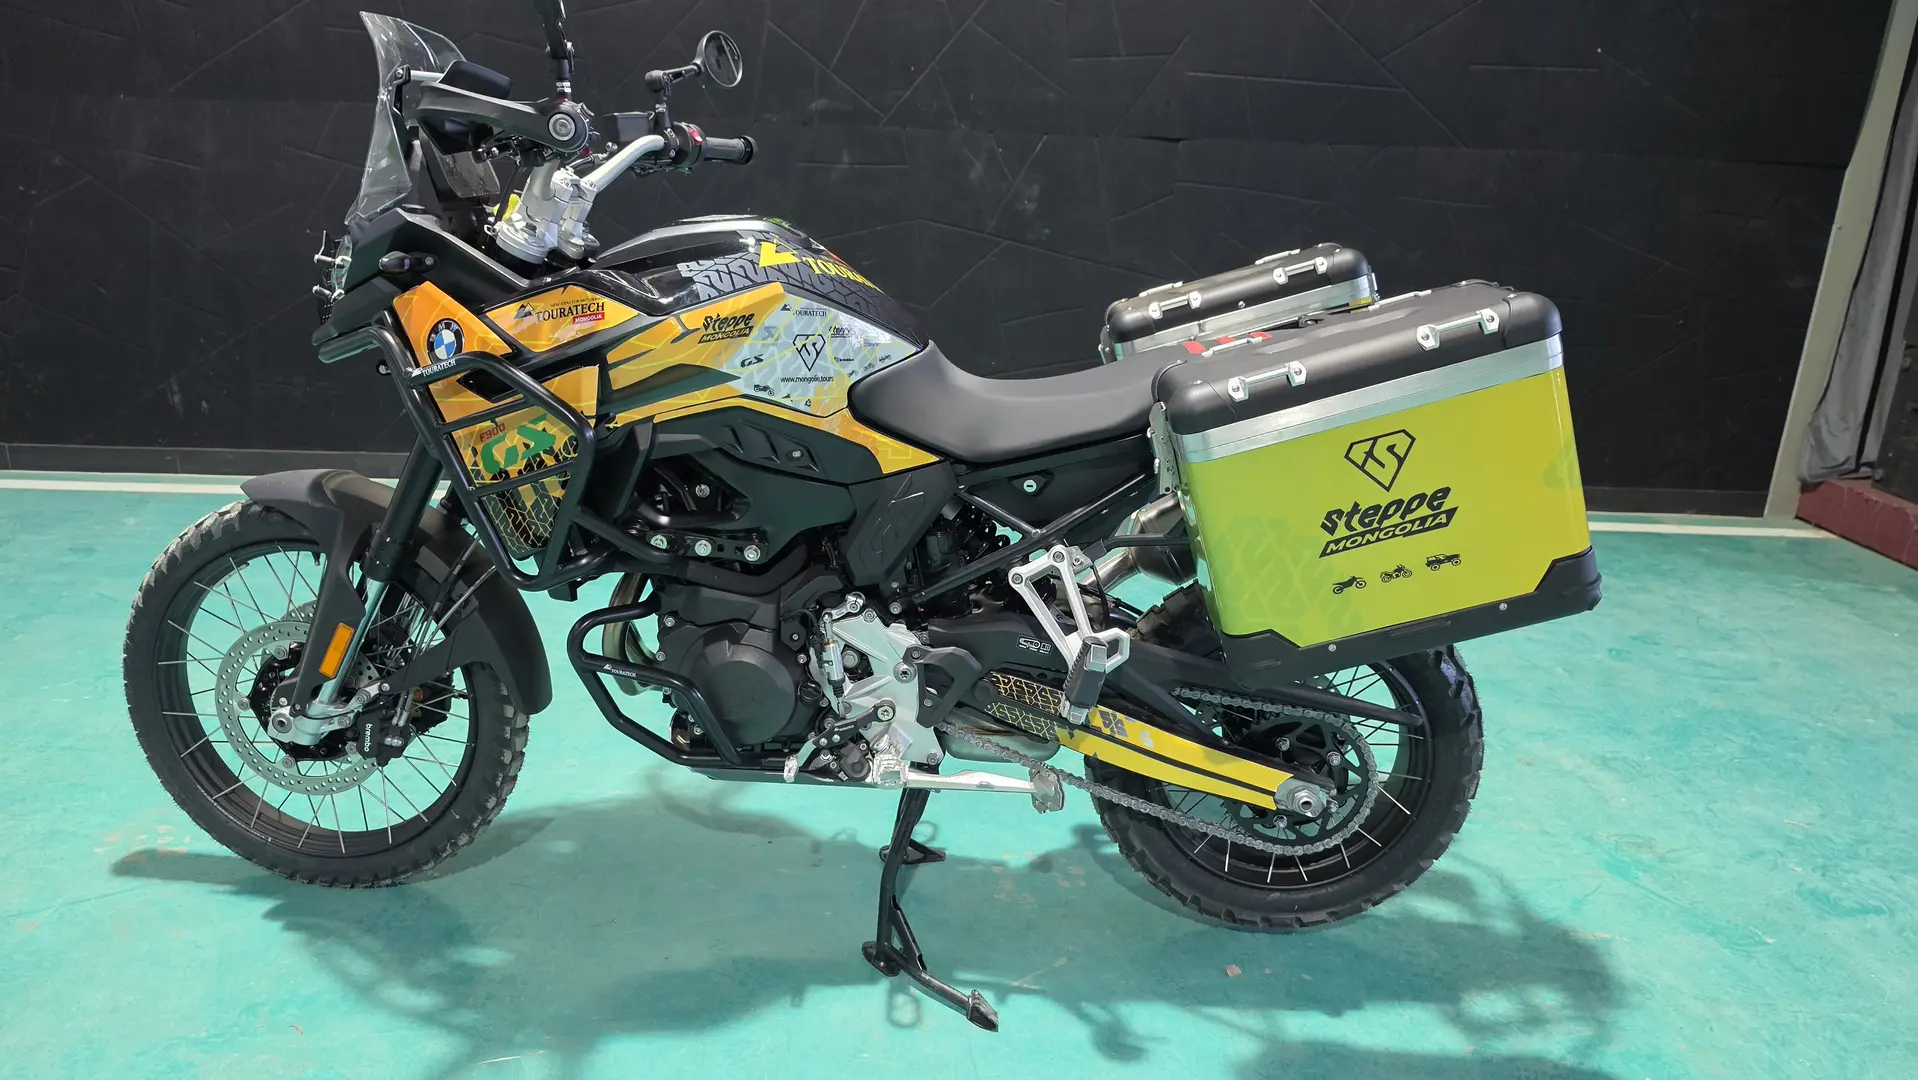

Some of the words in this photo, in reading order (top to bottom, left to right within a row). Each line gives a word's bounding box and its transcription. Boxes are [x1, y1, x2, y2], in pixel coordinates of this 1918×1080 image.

[536, 302, 605, 323] TOURATECH
[575, 314, 603, 322] MONGOLIA
[701, 328, 750, 342] MONGOLIA
[422, 359, 456, 377] TOURATECH
[740, 353, 764, 368] GS
[780, 375, 834, 384] www.mongolie.tours
[479, 422, 506, 442] F900
[1325, 513, 1447, 554] MONGOLIA
[364, 723, 373, 752] brembo
